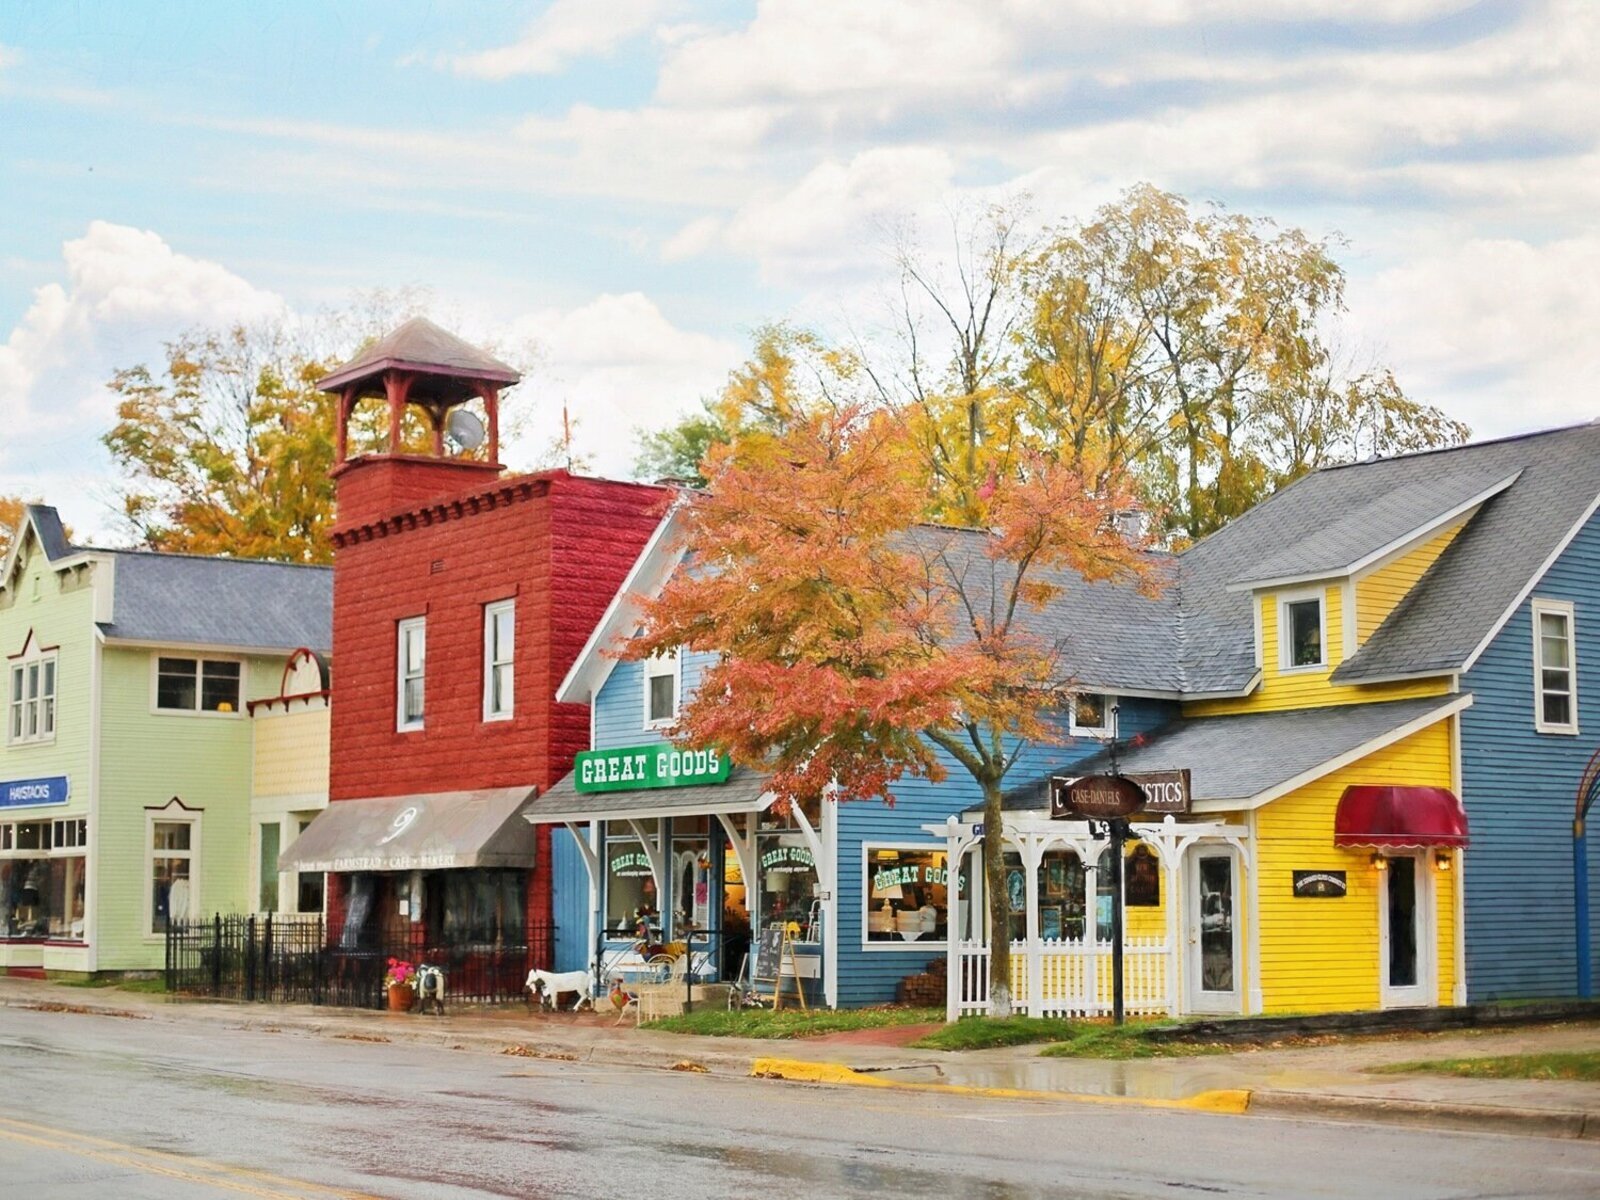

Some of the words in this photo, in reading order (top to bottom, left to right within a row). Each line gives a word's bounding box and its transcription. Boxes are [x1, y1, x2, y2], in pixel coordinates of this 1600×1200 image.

[582, 755, 646, 784] GREAT
[657, 749, 719, 778] GOODS
[10, 784, 50, 800] HAYSTACKS
[611, 853, 634, 871] GREAT
[762, 848, 788, 867] GREAT
[790, 847, 816, 866] GOODS
[874, 866, 918, 890] GREAT
[926, 867, 965, 891] GOOS
